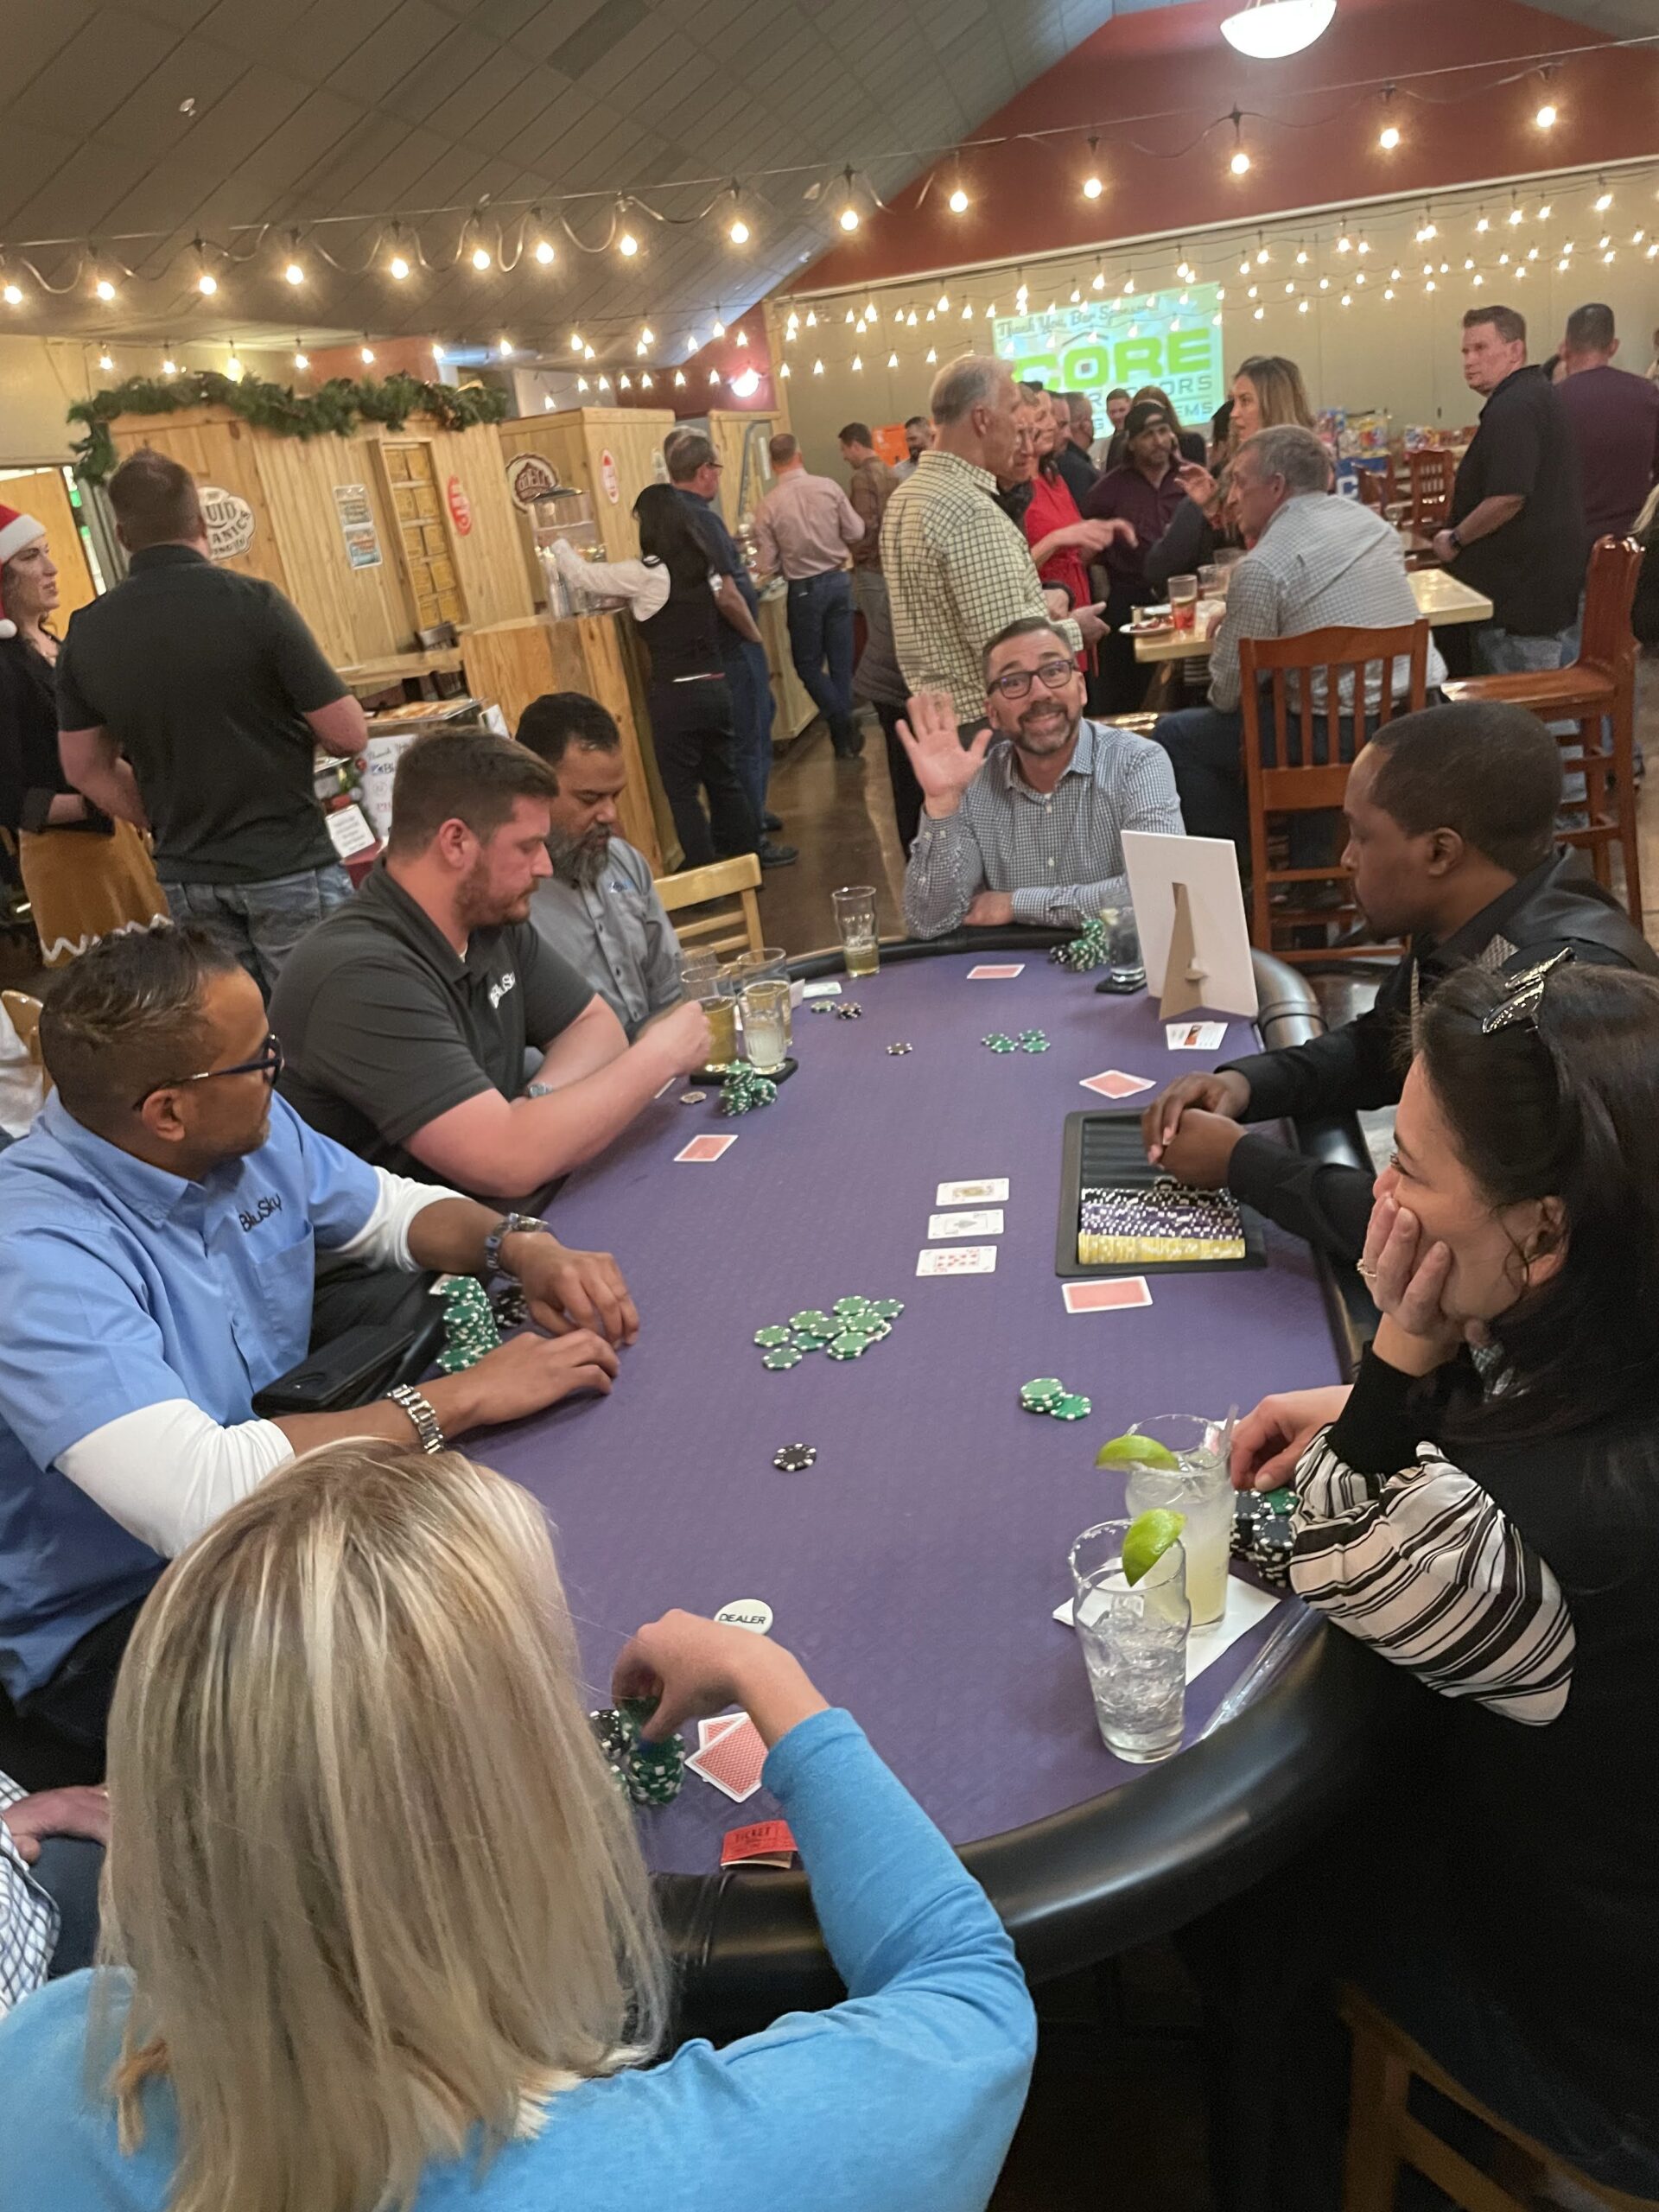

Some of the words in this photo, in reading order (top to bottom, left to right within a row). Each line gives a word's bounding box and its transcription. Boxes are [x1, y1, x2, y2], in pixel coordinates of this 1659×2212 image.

[1012, 327, 1211, 392] CORE
[238, 1192, 283, 1233] BluSky
[718, 1613, 766, 1624] DEALER
[734, 1826, 771, 1844] TICKET
